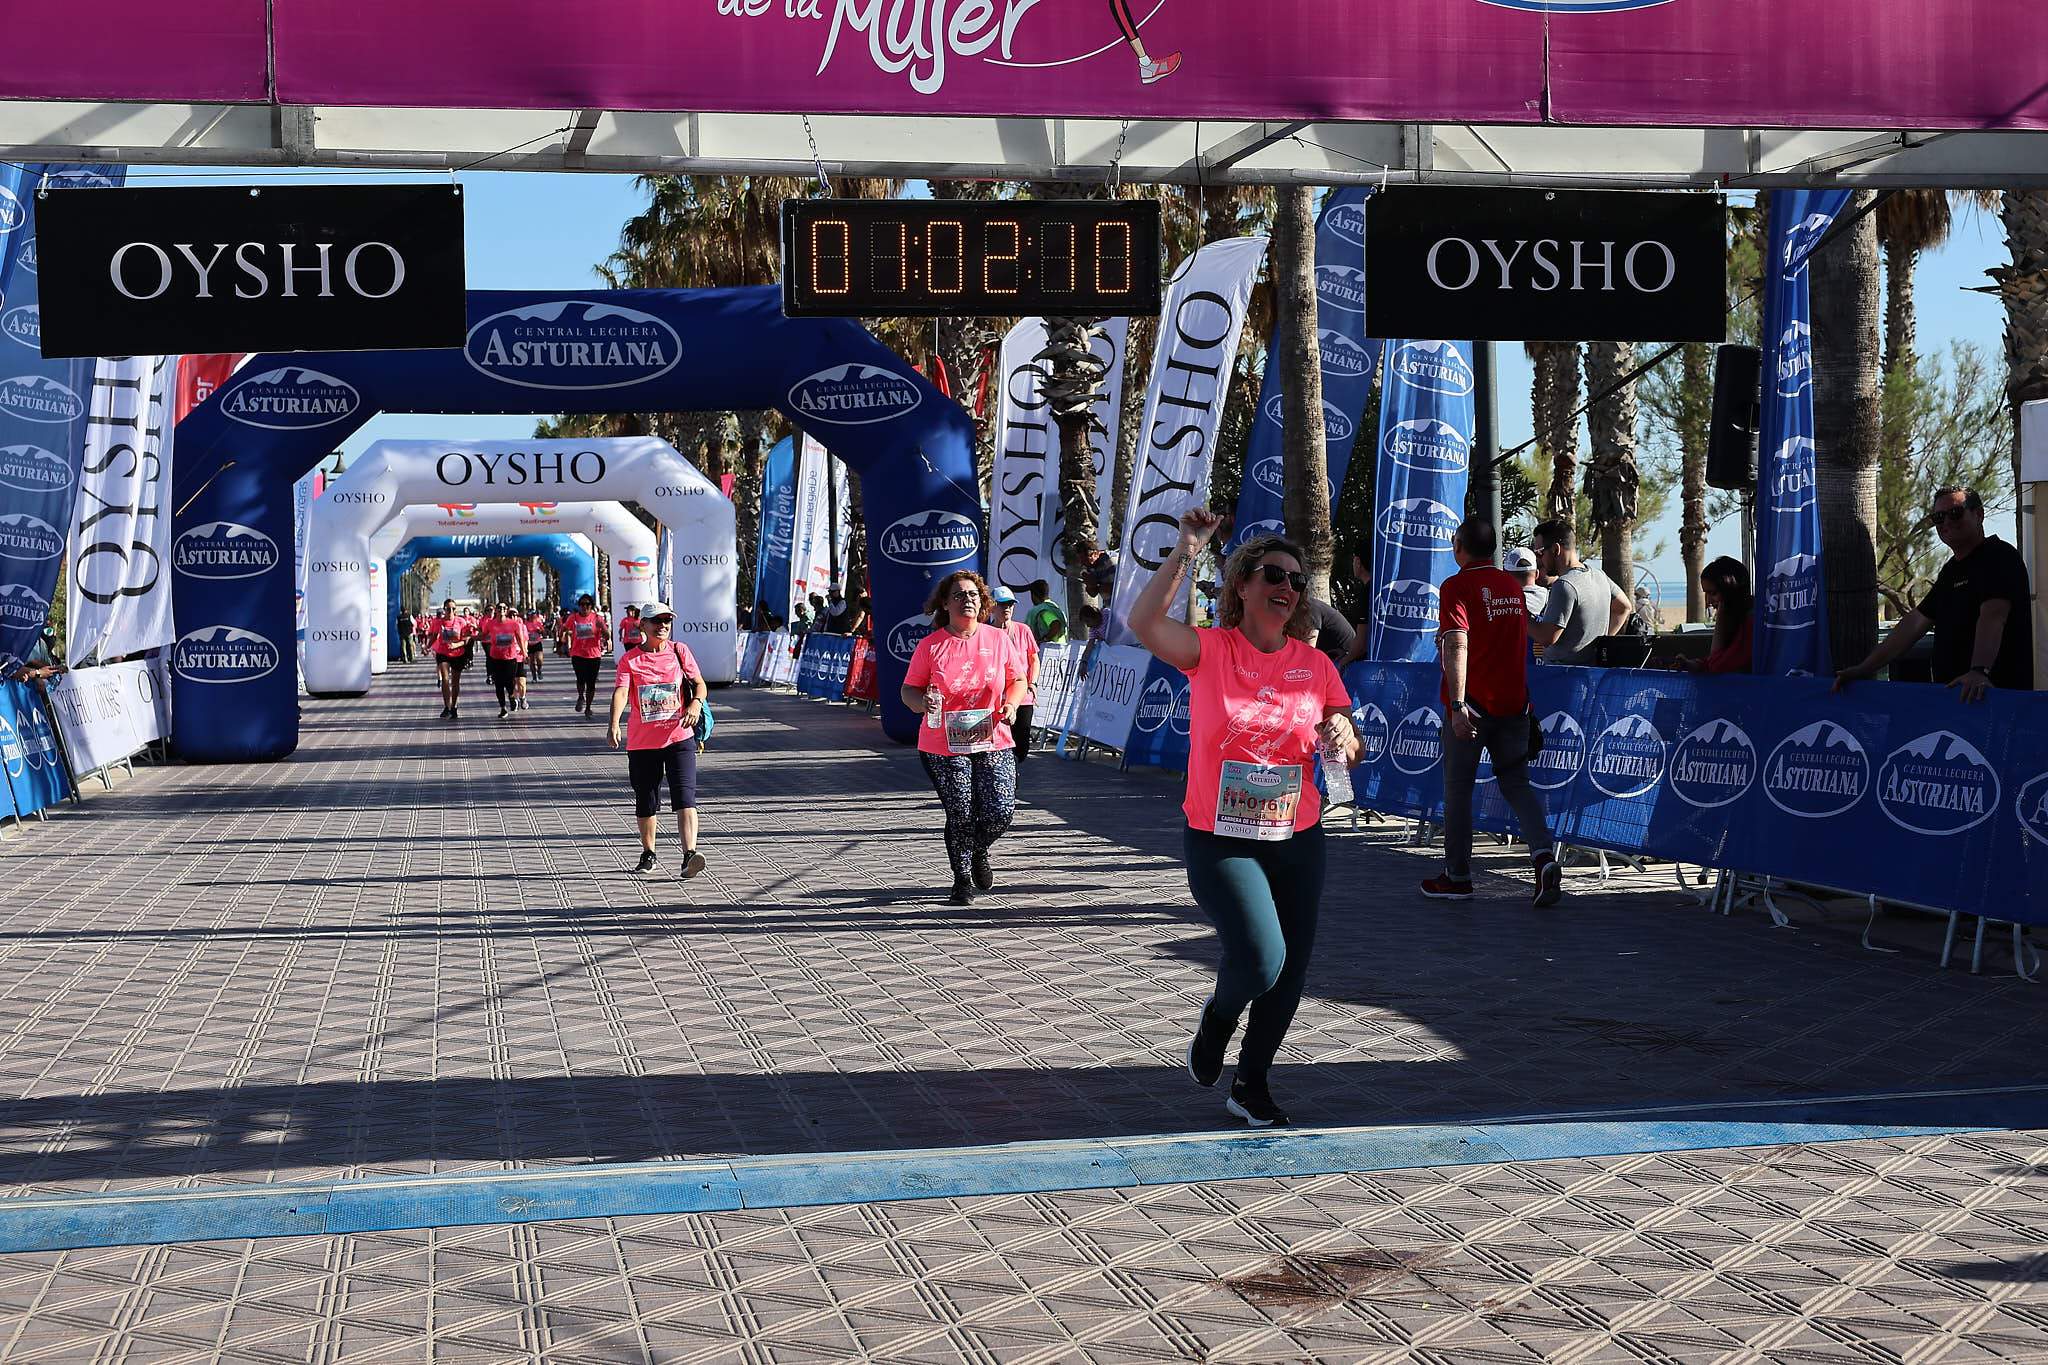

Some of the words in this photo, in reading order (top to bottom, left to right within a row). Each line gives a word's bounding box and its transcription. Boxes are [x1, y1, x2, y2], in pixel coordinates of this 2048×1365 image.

[816, 0, 1040, 94] Mujer
[812, 221, 1130, 293] 01:02:10
[1426, 237, 1676, 293] OYSHO
[110, 241, 405, 299] OYSHO
[514, 327, 583, 337] CENTRAL
[590, 327, 658, 337] LECHERA
[481, 328, 667, 366] ASTURIANA
[252, 386, 297, 395] CENTRAL
[300, 388, 346, 396] LECHERA
[816, 382, 861, 392] CENTRAL
[0, 386, 76, 416] ASTURIANA
[229, 390, 349, 413] ASTURIANA
[800, 388, 914, 411] ASTURIANA
[1131, 291, 1232, 572] OYSHO
[1390, 432, 1465, 467] ASTURIANA
[0, 463, 66, 484] STURIANA
[436, 452, 606, 485] OYSHO
[333, 493, 385, 503] OYSHO
[655, 486, 705, 497] OYSHO
[767, 484, 795, 560] Marlene
[177, 543, 272, 565] ASTURIANA
[887, 532, 976, 553] ASTURIANA
[311, 561, 360, 573] OYSHO
[682, 555, 729, 566] OYSHO
[312, 630, 360, 642] OYSHO
[683, 622, 729, 633] OYSHO
[178, 647, 272, 668] ASTURIANA
[1091, 660, 1136, 706] OYSHO
[1393, 729, 1440, 758] ASTURIANA
[1692, 748, 1718, 758] CENTRAL
[1721, 750, 1749, 759] LECHERA
[1592, 743, 1657, 778] ASTURIANA
[1674, 749, 1746, 786] ASTURIANA
[1790, 753, 1823, 764] CENTRAL
[1825, 755, 1861, 767] LECHERA
[1769, 754, 1858, 796] ASTURIANA
[1903, 764, 1942, 777] CENTRAL
[1945, 767, 1984, 782] LECHERA
[1882, 763, 1984, 814] ASTURIANA
[1224, 825, 1252, 835] OYSHO
